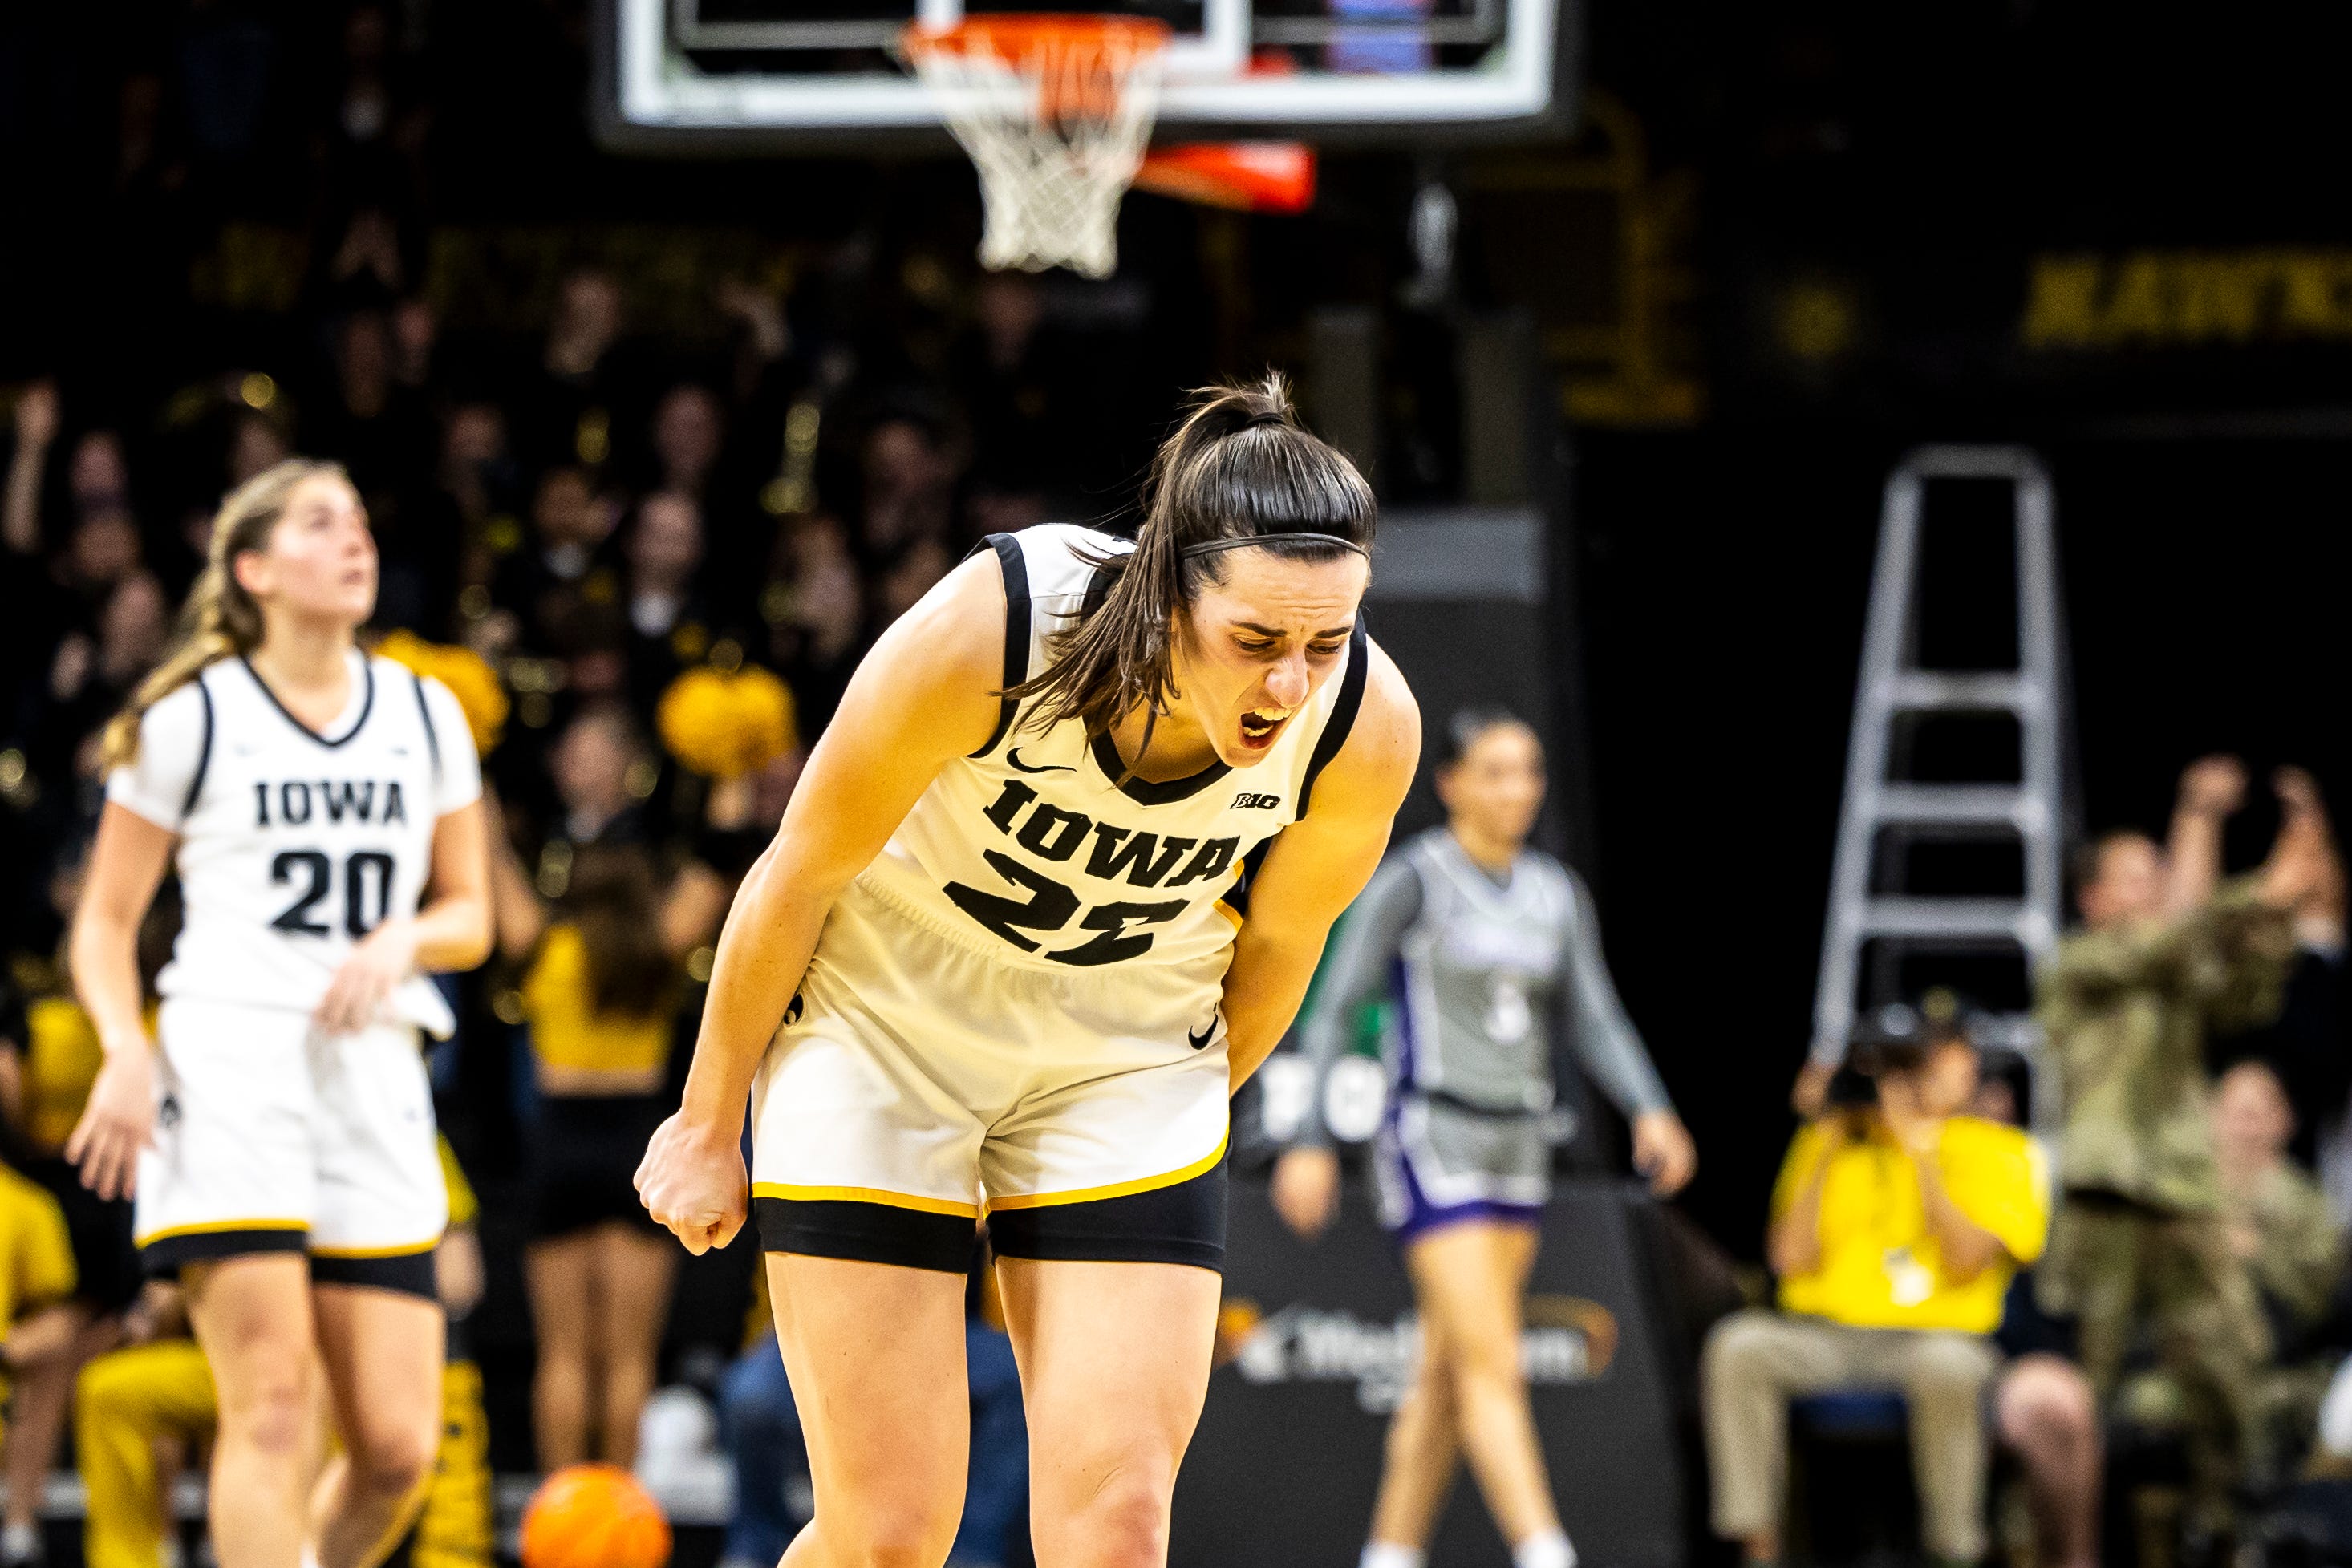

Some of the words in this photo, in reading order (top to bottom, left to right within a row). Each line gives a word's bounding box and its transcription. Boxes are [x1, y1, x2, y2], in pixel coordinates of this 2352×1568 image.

[254, 780, 405, 828] IOWA
[983, 780, 1240, 888] IOWA
[270, 850, 395, 940] 20
[943, 849, 1190, 966] 22
